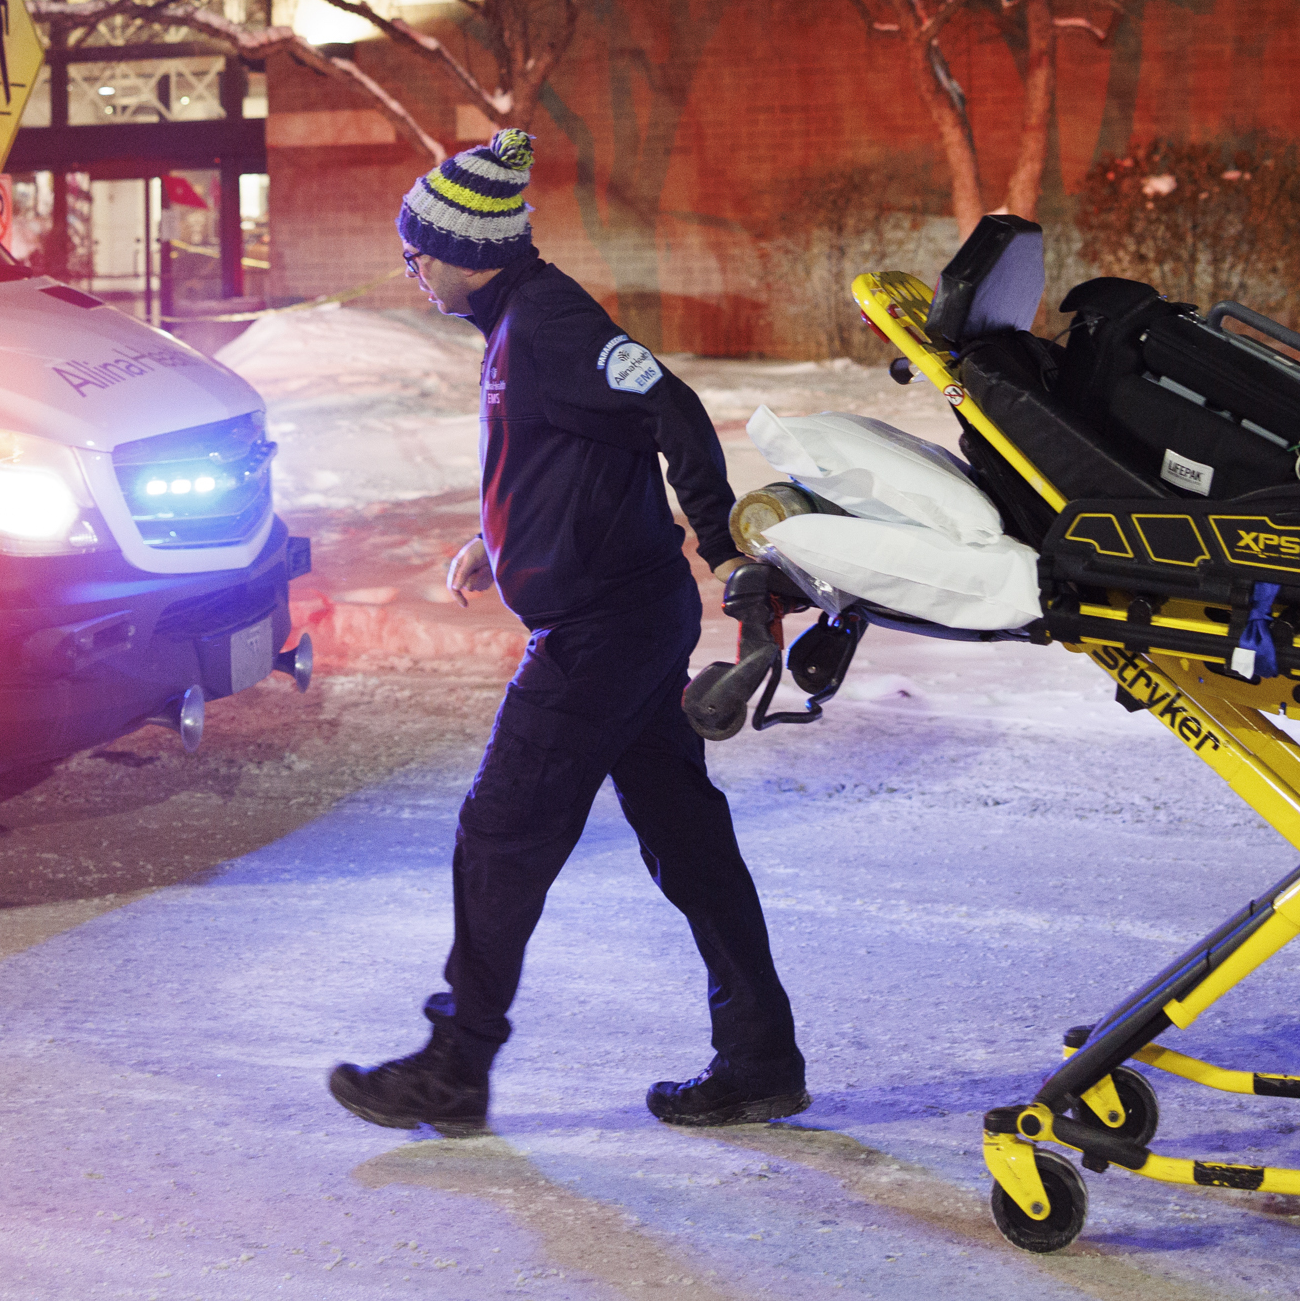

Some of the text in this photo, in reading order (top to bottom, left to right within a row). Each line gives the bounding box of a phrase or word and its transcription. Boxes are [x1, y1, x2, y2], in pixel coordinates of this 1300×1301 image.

[597, 335, 626, 366] PARAMEDIC
[634, 366, 657, 387] EMS
[1167, 459, 1204, 482] LIFEPAK
[1091, 645, 1221, 751] stryker
